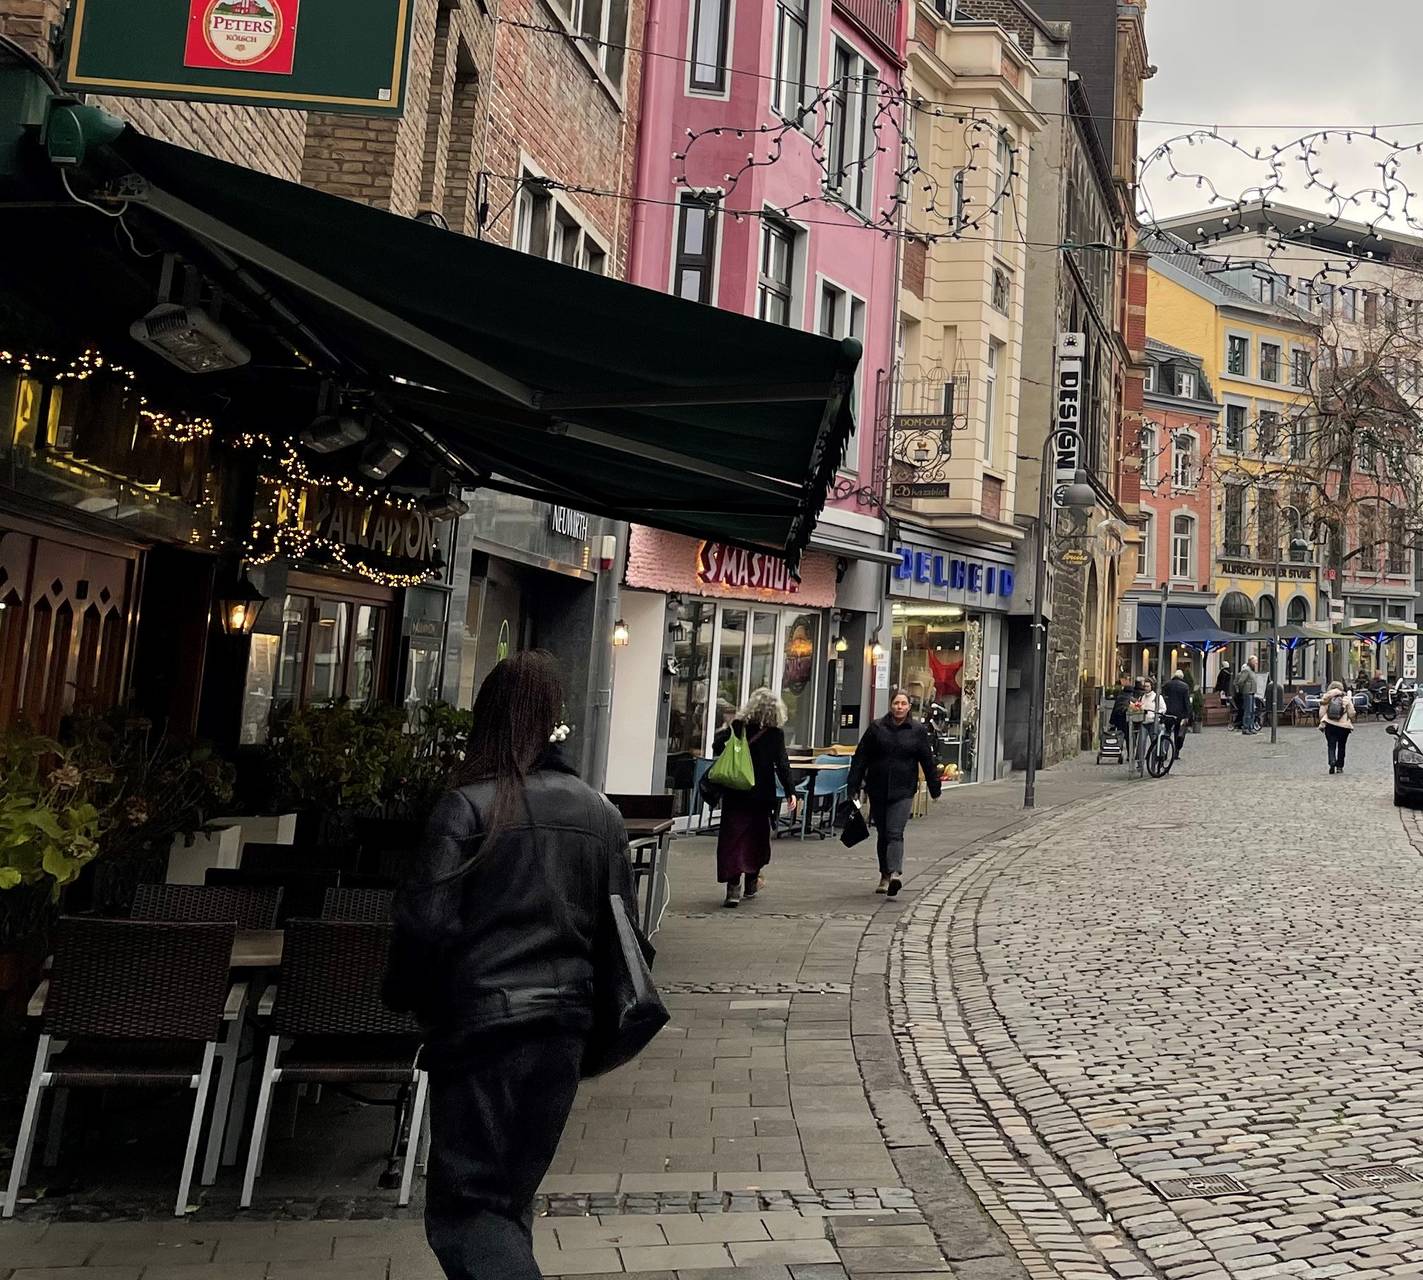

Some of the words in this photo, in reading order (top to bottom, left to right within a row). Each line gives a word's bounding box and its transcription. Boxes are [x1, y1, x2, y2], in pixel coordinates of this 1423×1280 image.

[213, 16, 273, 34] PETERS
[226, 34, 257, 43] KÖLSCH
[1056, 371, 1079, 470] DESIGN
[895, 547, 1015, 598] DELHEID
[1221, 563, 1260, 577] ALBRECHT
[1288, 568, 1312, 579] STUBE
